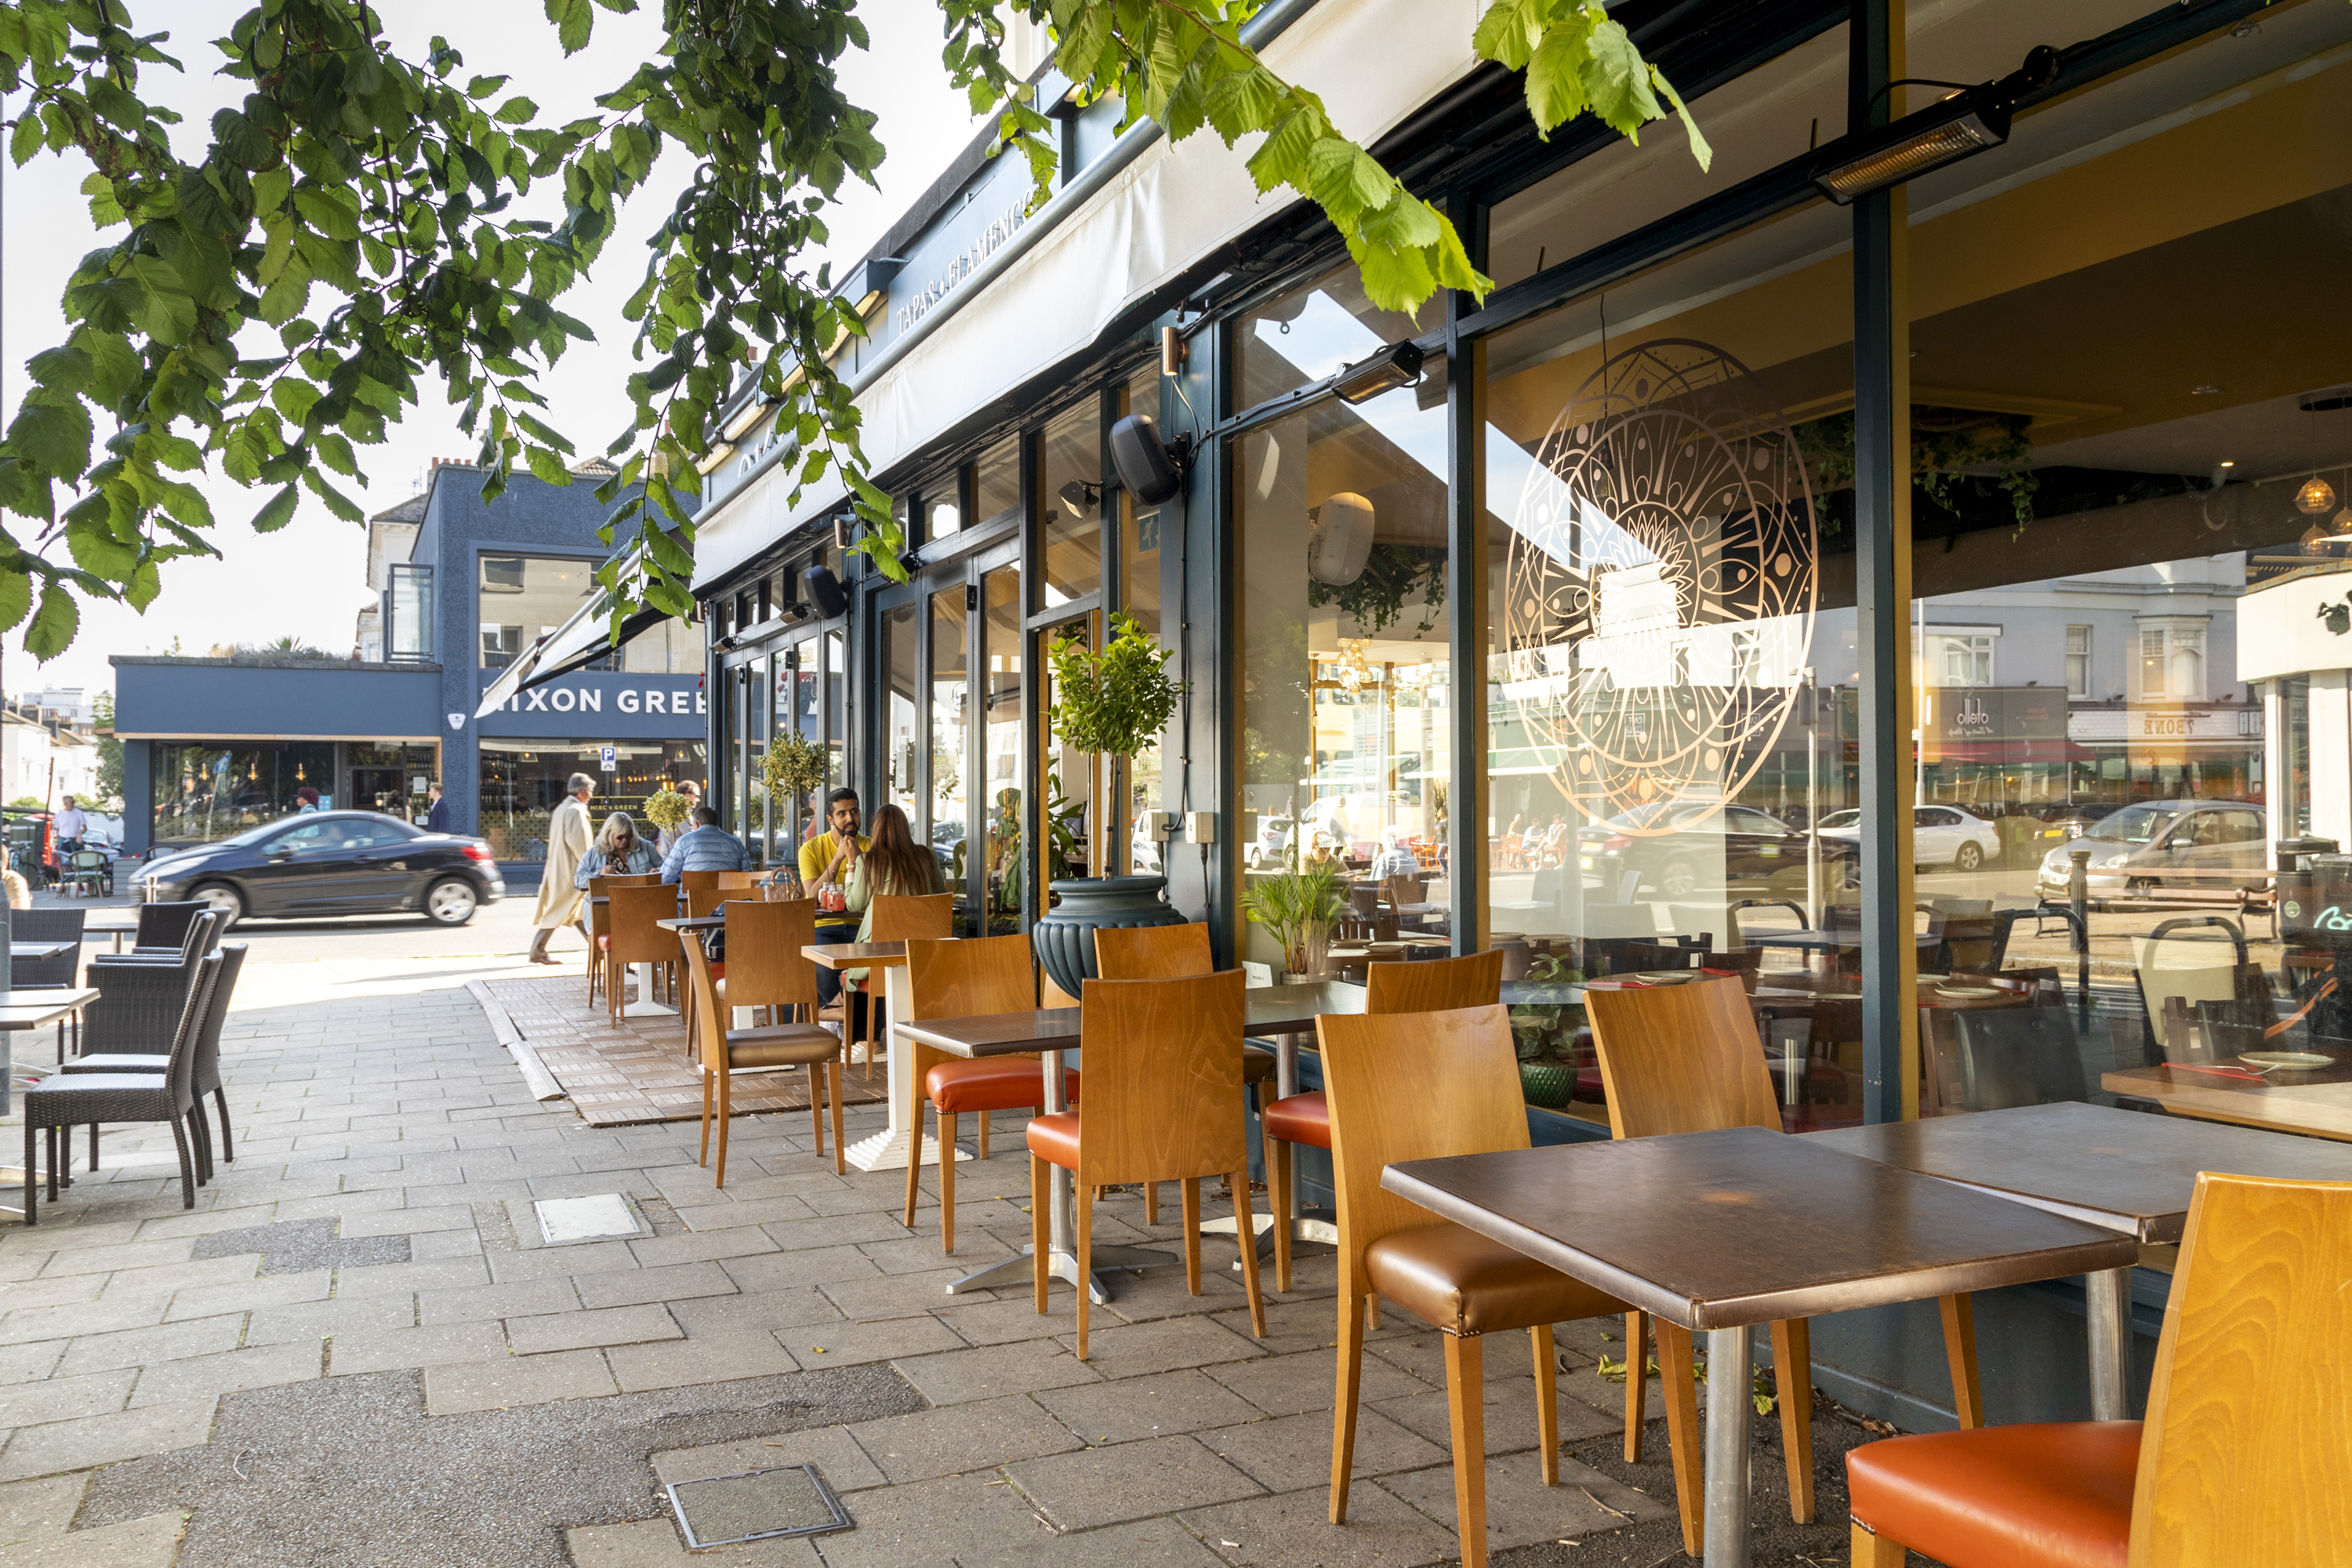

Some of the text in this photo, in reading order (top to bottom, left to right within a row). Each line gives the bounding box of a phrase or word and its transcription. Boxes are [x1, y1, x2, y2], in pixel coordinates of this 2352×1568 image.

[897, 279, 938, 336] TAPAS
[482, 688, 706, 714] IXON GREE
[604, 749, 613, 760] P
